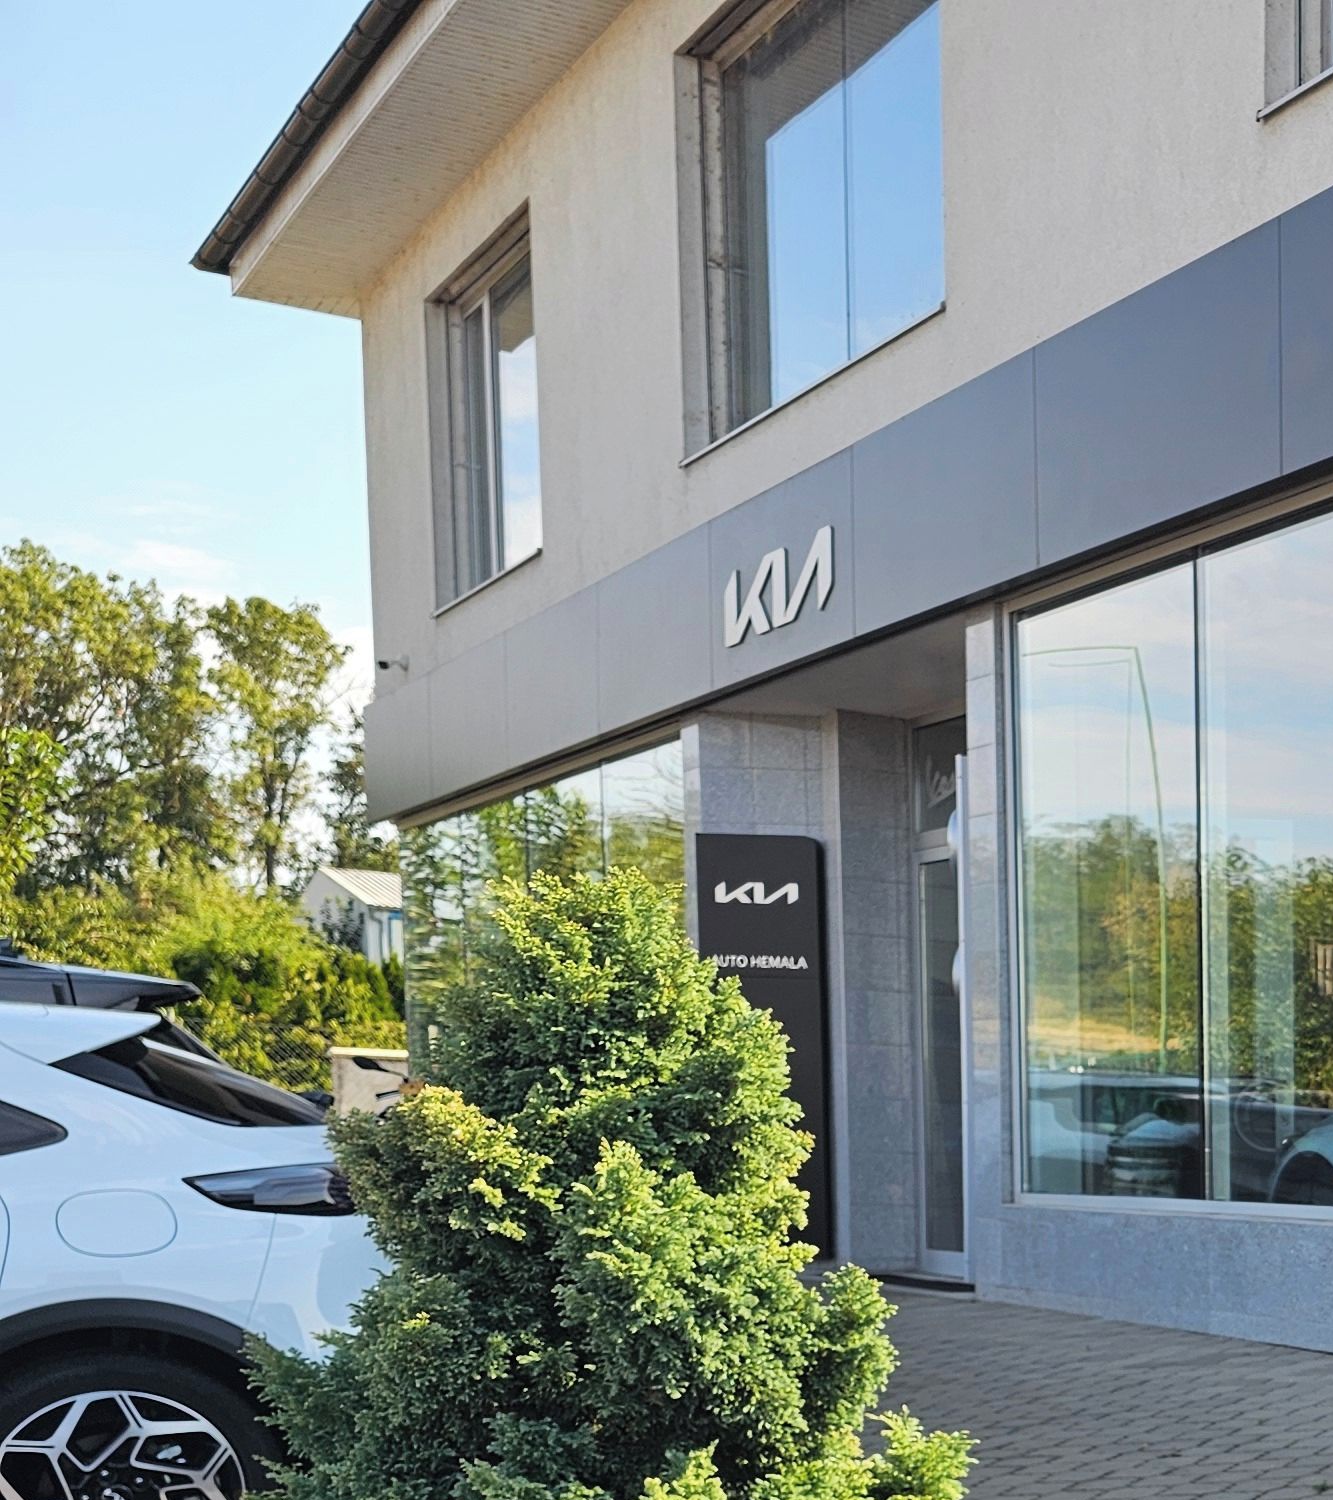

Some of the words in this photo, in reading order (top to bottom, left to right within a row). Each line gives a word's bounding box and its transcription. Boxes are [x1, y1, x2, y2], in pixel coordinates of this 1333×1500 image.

[724, 524, 835, 649] KIA
[714, 880, 800, 906] KIA
[750, 953, 808, 970] HEMALA
